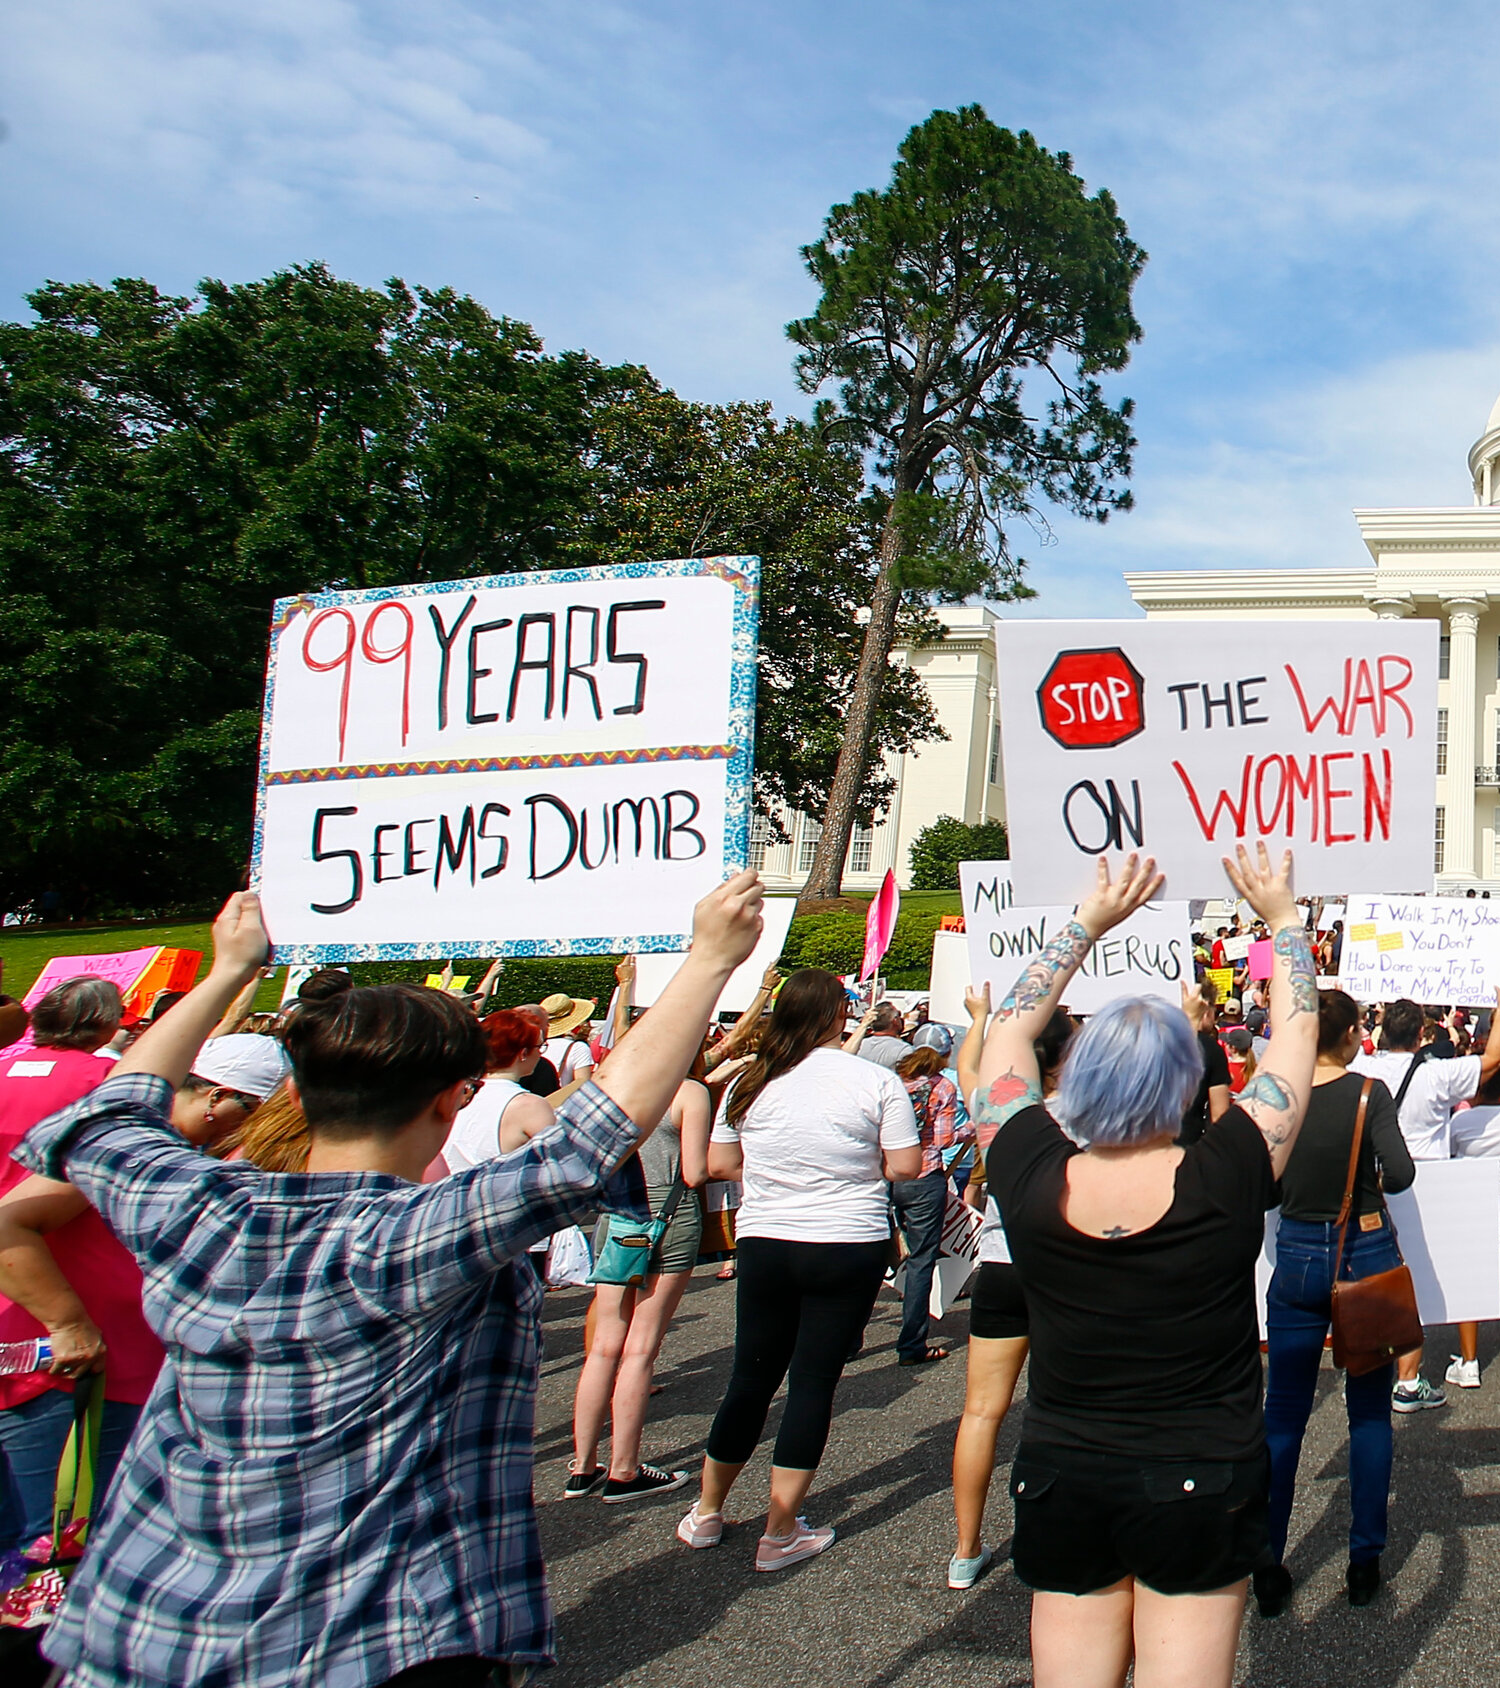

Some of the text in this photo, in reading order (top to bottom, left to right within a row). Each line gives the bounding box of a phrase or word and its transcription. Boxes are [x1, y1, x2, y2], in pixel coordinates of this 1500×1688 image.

[302, 595, 666, 762] 99 YEARS
[1051, 654, 1414, 739] STOP THE WAR
[1062, 748, 1393, 856] ON WOMEN
[310, 789, 707, 915] SEEMS DUMB
[990, 916, 1046, 957] OWN
[1365, 903, 1382, 920] I
[1388, 904, 1424, 923] Walk
[1430, 907, 1444, 925] In
[1447, 908, 1468, 933] My
[1409, 930, 1435, 951] You
[1438, 933, 1474, 950] Don't
[1344, 977, 1372, 993] Tell
[1380, 978, 1402, 994] Me
[1410, 978, 1434, 1000] My
[1435, 976, 1484, 998] Medical
[1447, 959, 1466, 979] Try
[1469, 959, 1485, 974] To
